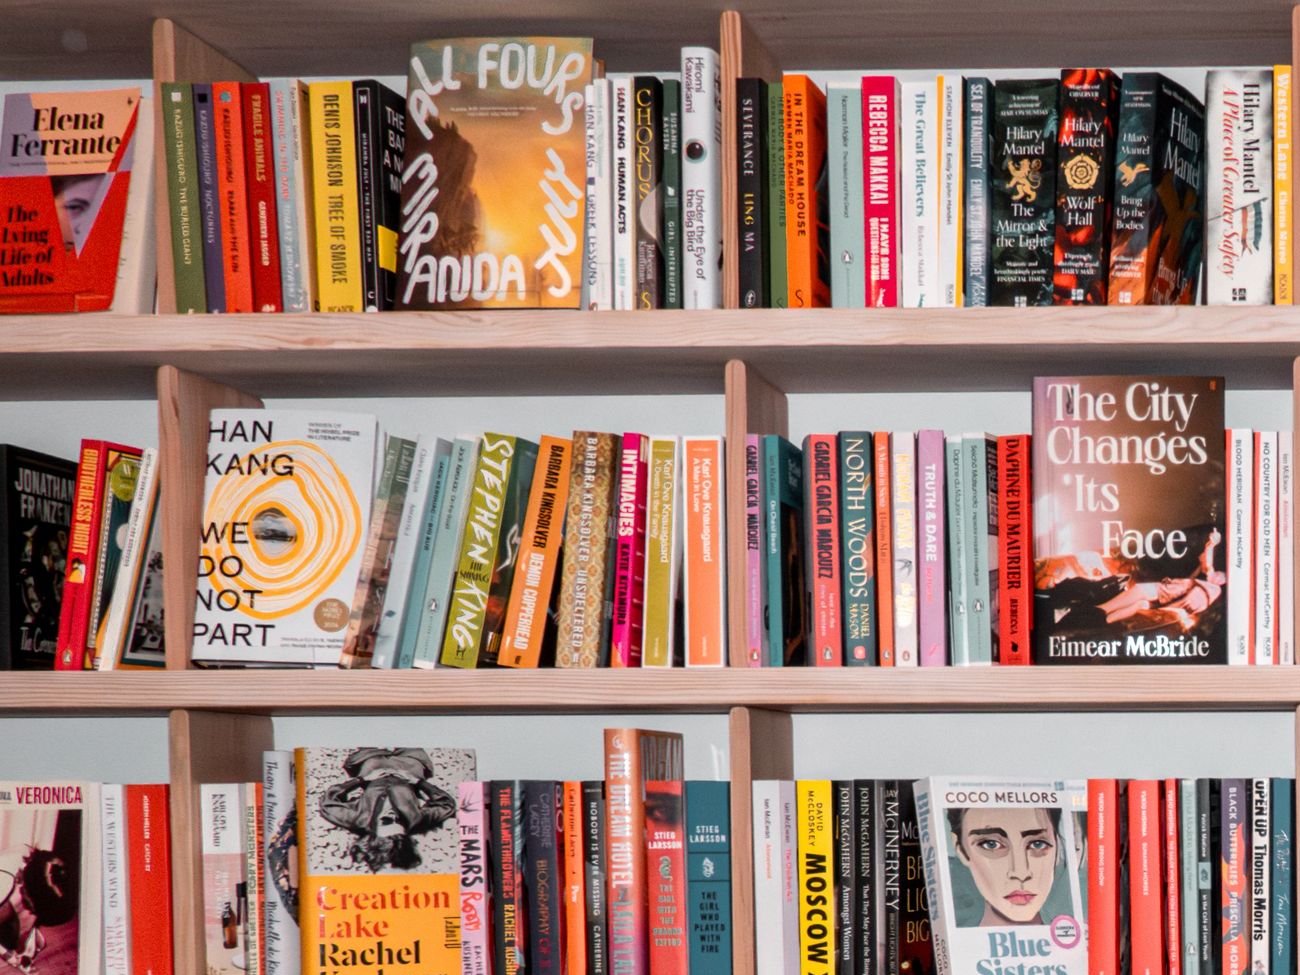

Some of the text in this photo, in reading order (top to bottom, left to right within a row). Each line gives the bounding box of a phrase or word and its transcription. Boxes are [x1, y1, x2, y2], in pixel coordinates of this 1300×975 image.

[409, 43, 585, 141] ALL FOURS
[33, 108, 104, 131] Elena
[10, 135, 121, 158] Ferrante
[869, 95, 888, 205] REBECCA MAKKAI
[617, 87, 627, 235] HAN KANG HUMAN ACTS
[534, 147, 584, 299] JULY
[1047, 382, 1198, 432] The City
[1048, 425, 1208, 474] Changes
[845, 438, 868, 598] NORTH WOODS
[452, 433, 514, 649] STEPHEN KING
[1100, 520, 1188, 559] Face
[1048, 635, 1210, 658] Eimear McBride
[16, 786, 82, 805] VERONICA
[945, 791, 1058, 804] COCO MELLORS
[689, 834, 727, 844] LARSSON
[695, 825, 720, 835] STIEG
[316, 884, 451, 911] Creation
[699, 902, 720, 911] GIRL
[701, 892, 718, 900] THE
[805, 853, 828, 964] MOSCOW
[318, 913, 389, 940] Lake
[695, 923, 726, 932] PLAYED
[700, 913, 720, 922] WHO
[699, 934, 721, 943] WITH
[701, 944, 720, 954] FIRE
[988, 931, 1051, 959] Blue
[319, 940, 421, 967] Rachel
